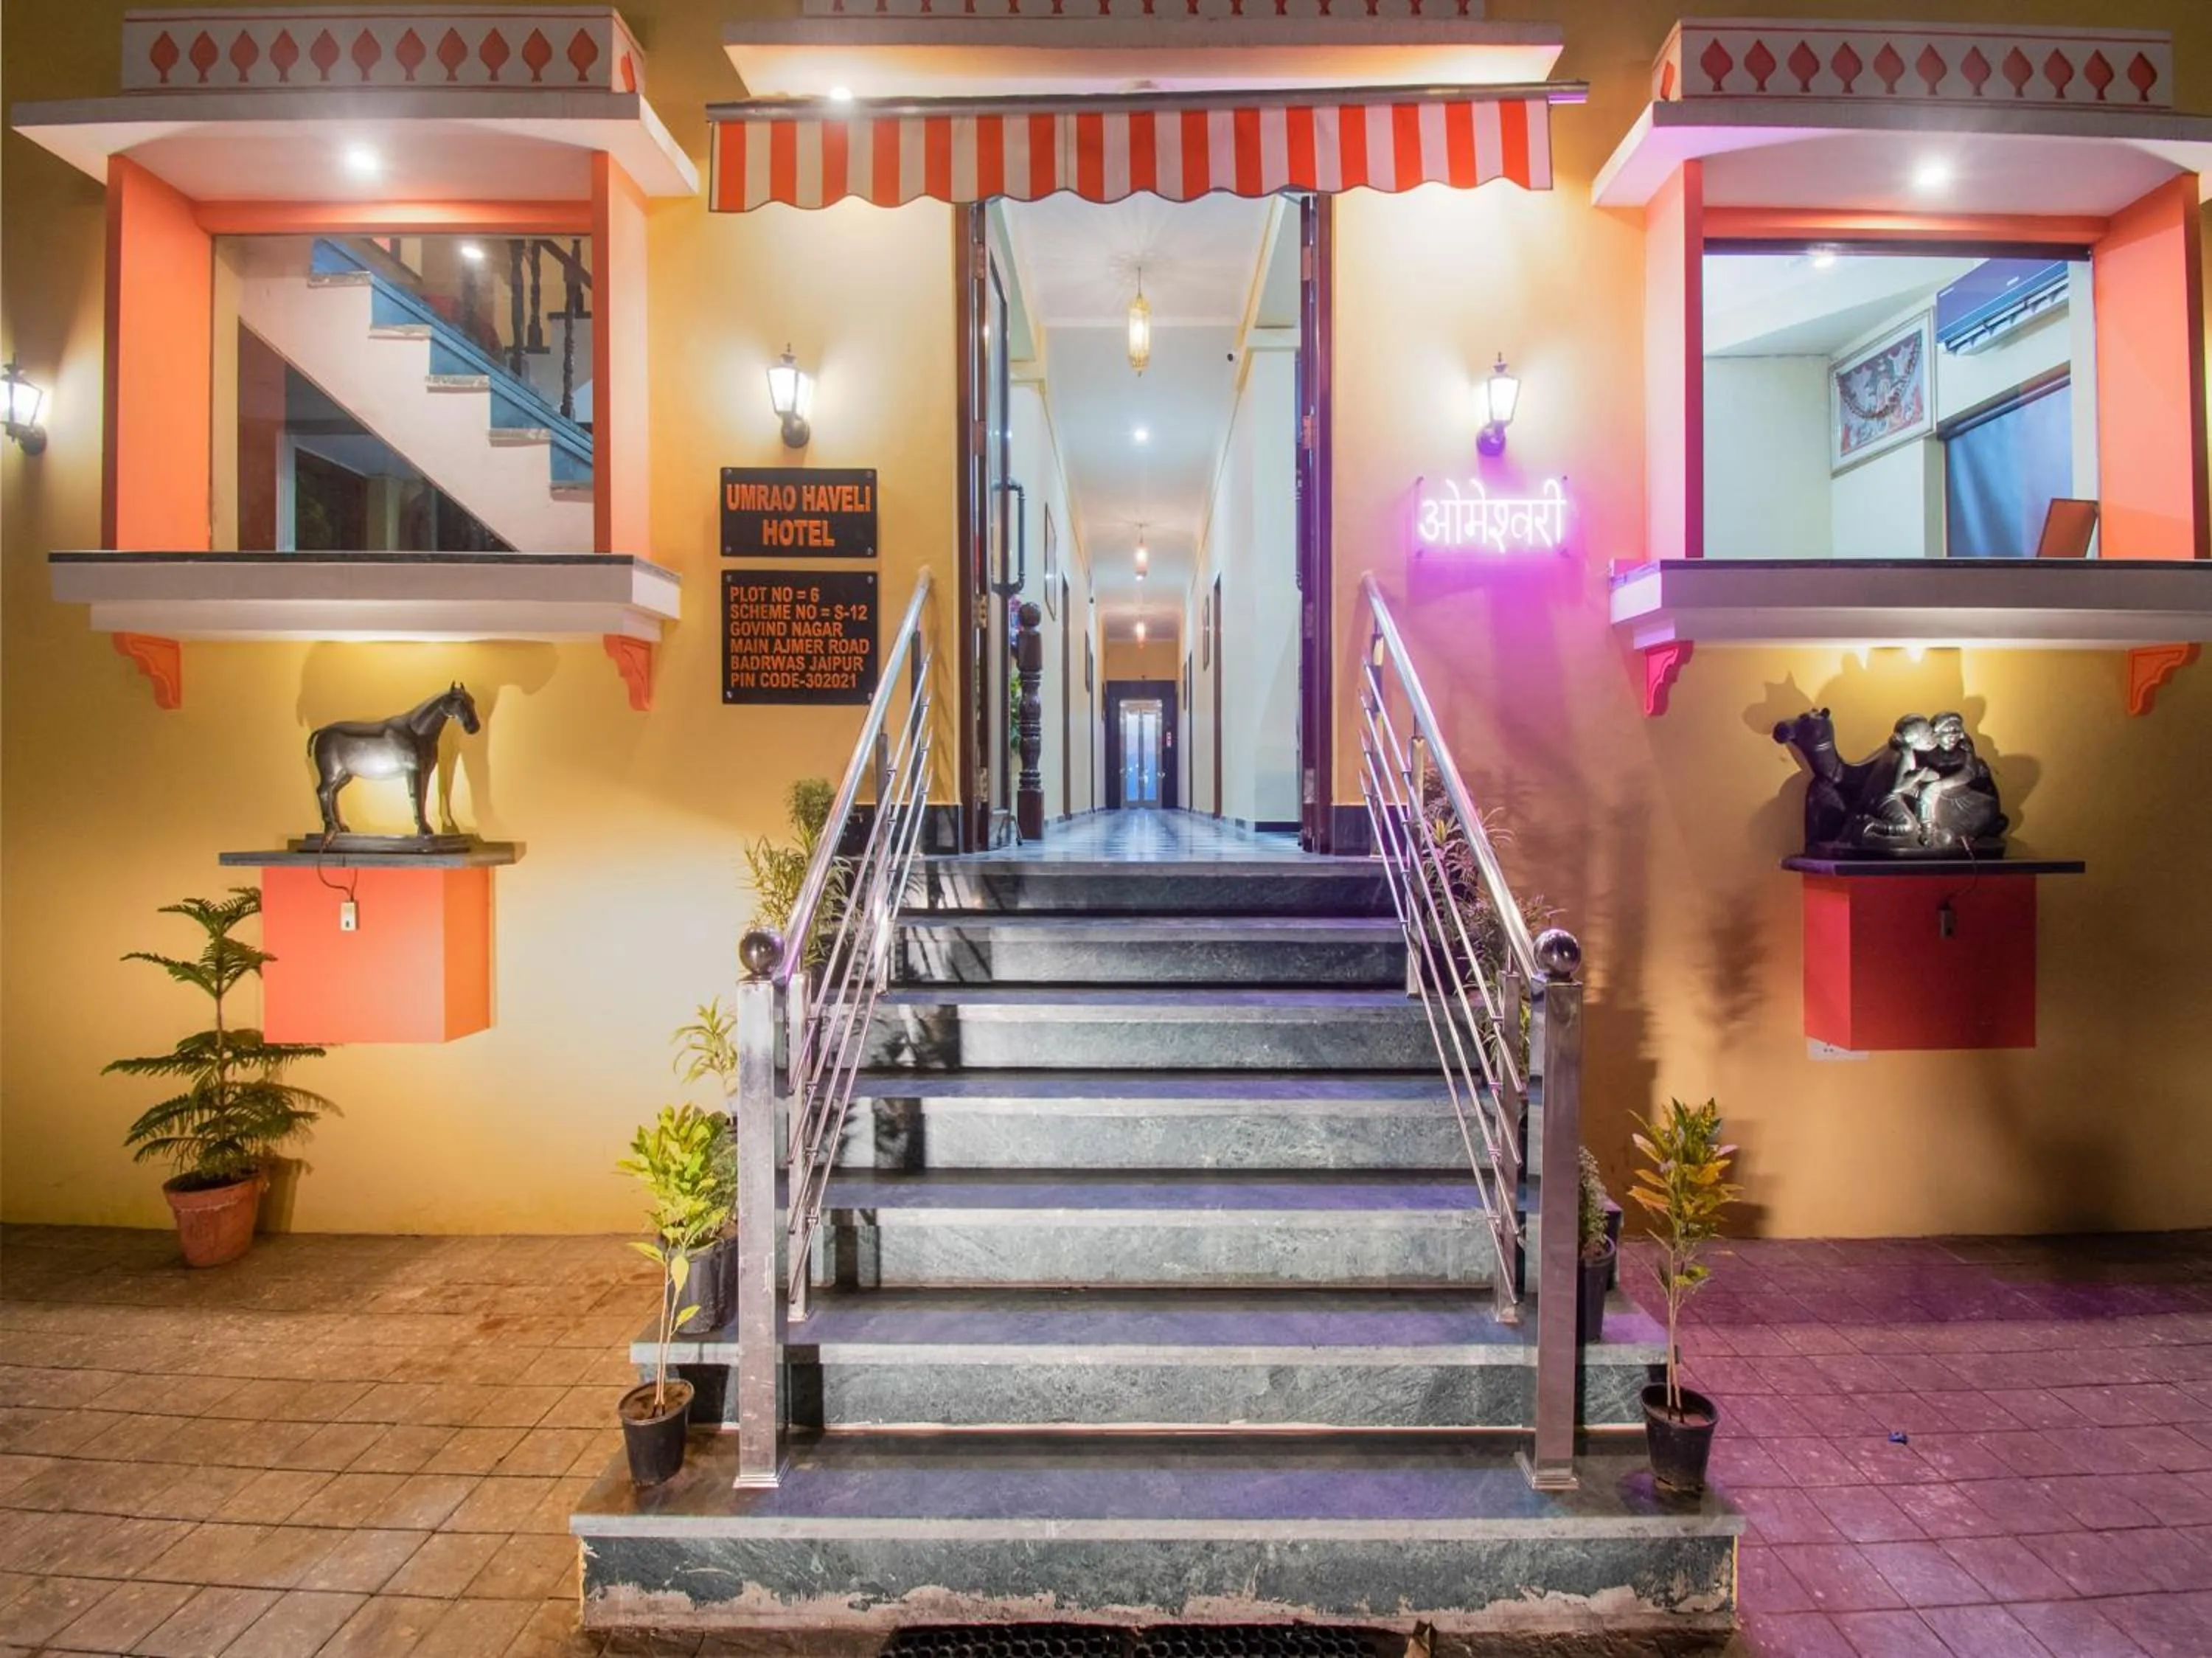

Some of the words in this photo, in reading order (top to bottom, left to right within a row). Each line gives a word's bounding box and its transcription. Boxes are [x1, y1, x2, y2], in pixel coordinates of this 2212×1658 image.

[726, 484, 797, 511] UMRAO
[801, 485, 871, 513] HAVELI
[762, 519, 835, 547] HOTEL
[730, 587, 768, 603] PLOT
[772, 588, 793, 603] NO
[811, 588, 820, 603] 6
[730, 604, 790, 620] SCHEME
[796, 605, 816, 620] NO
[834, 605, 868, 620] S-12
[730, 622, 787, 637] GOVIND
[792, 622, 843, 637] NAGAR
[730, 639, 768, 653] MAIN
[773, 639, 824, 654] AJMER
[829, 639, 869, 654] ROAD
[731, 656, 805, 670] BADRWAS
[809, 656, 864, 671] JAIPUR
[731, 673, 755, 687] PIN
[760, 673, 857, 688] CODE-302021
